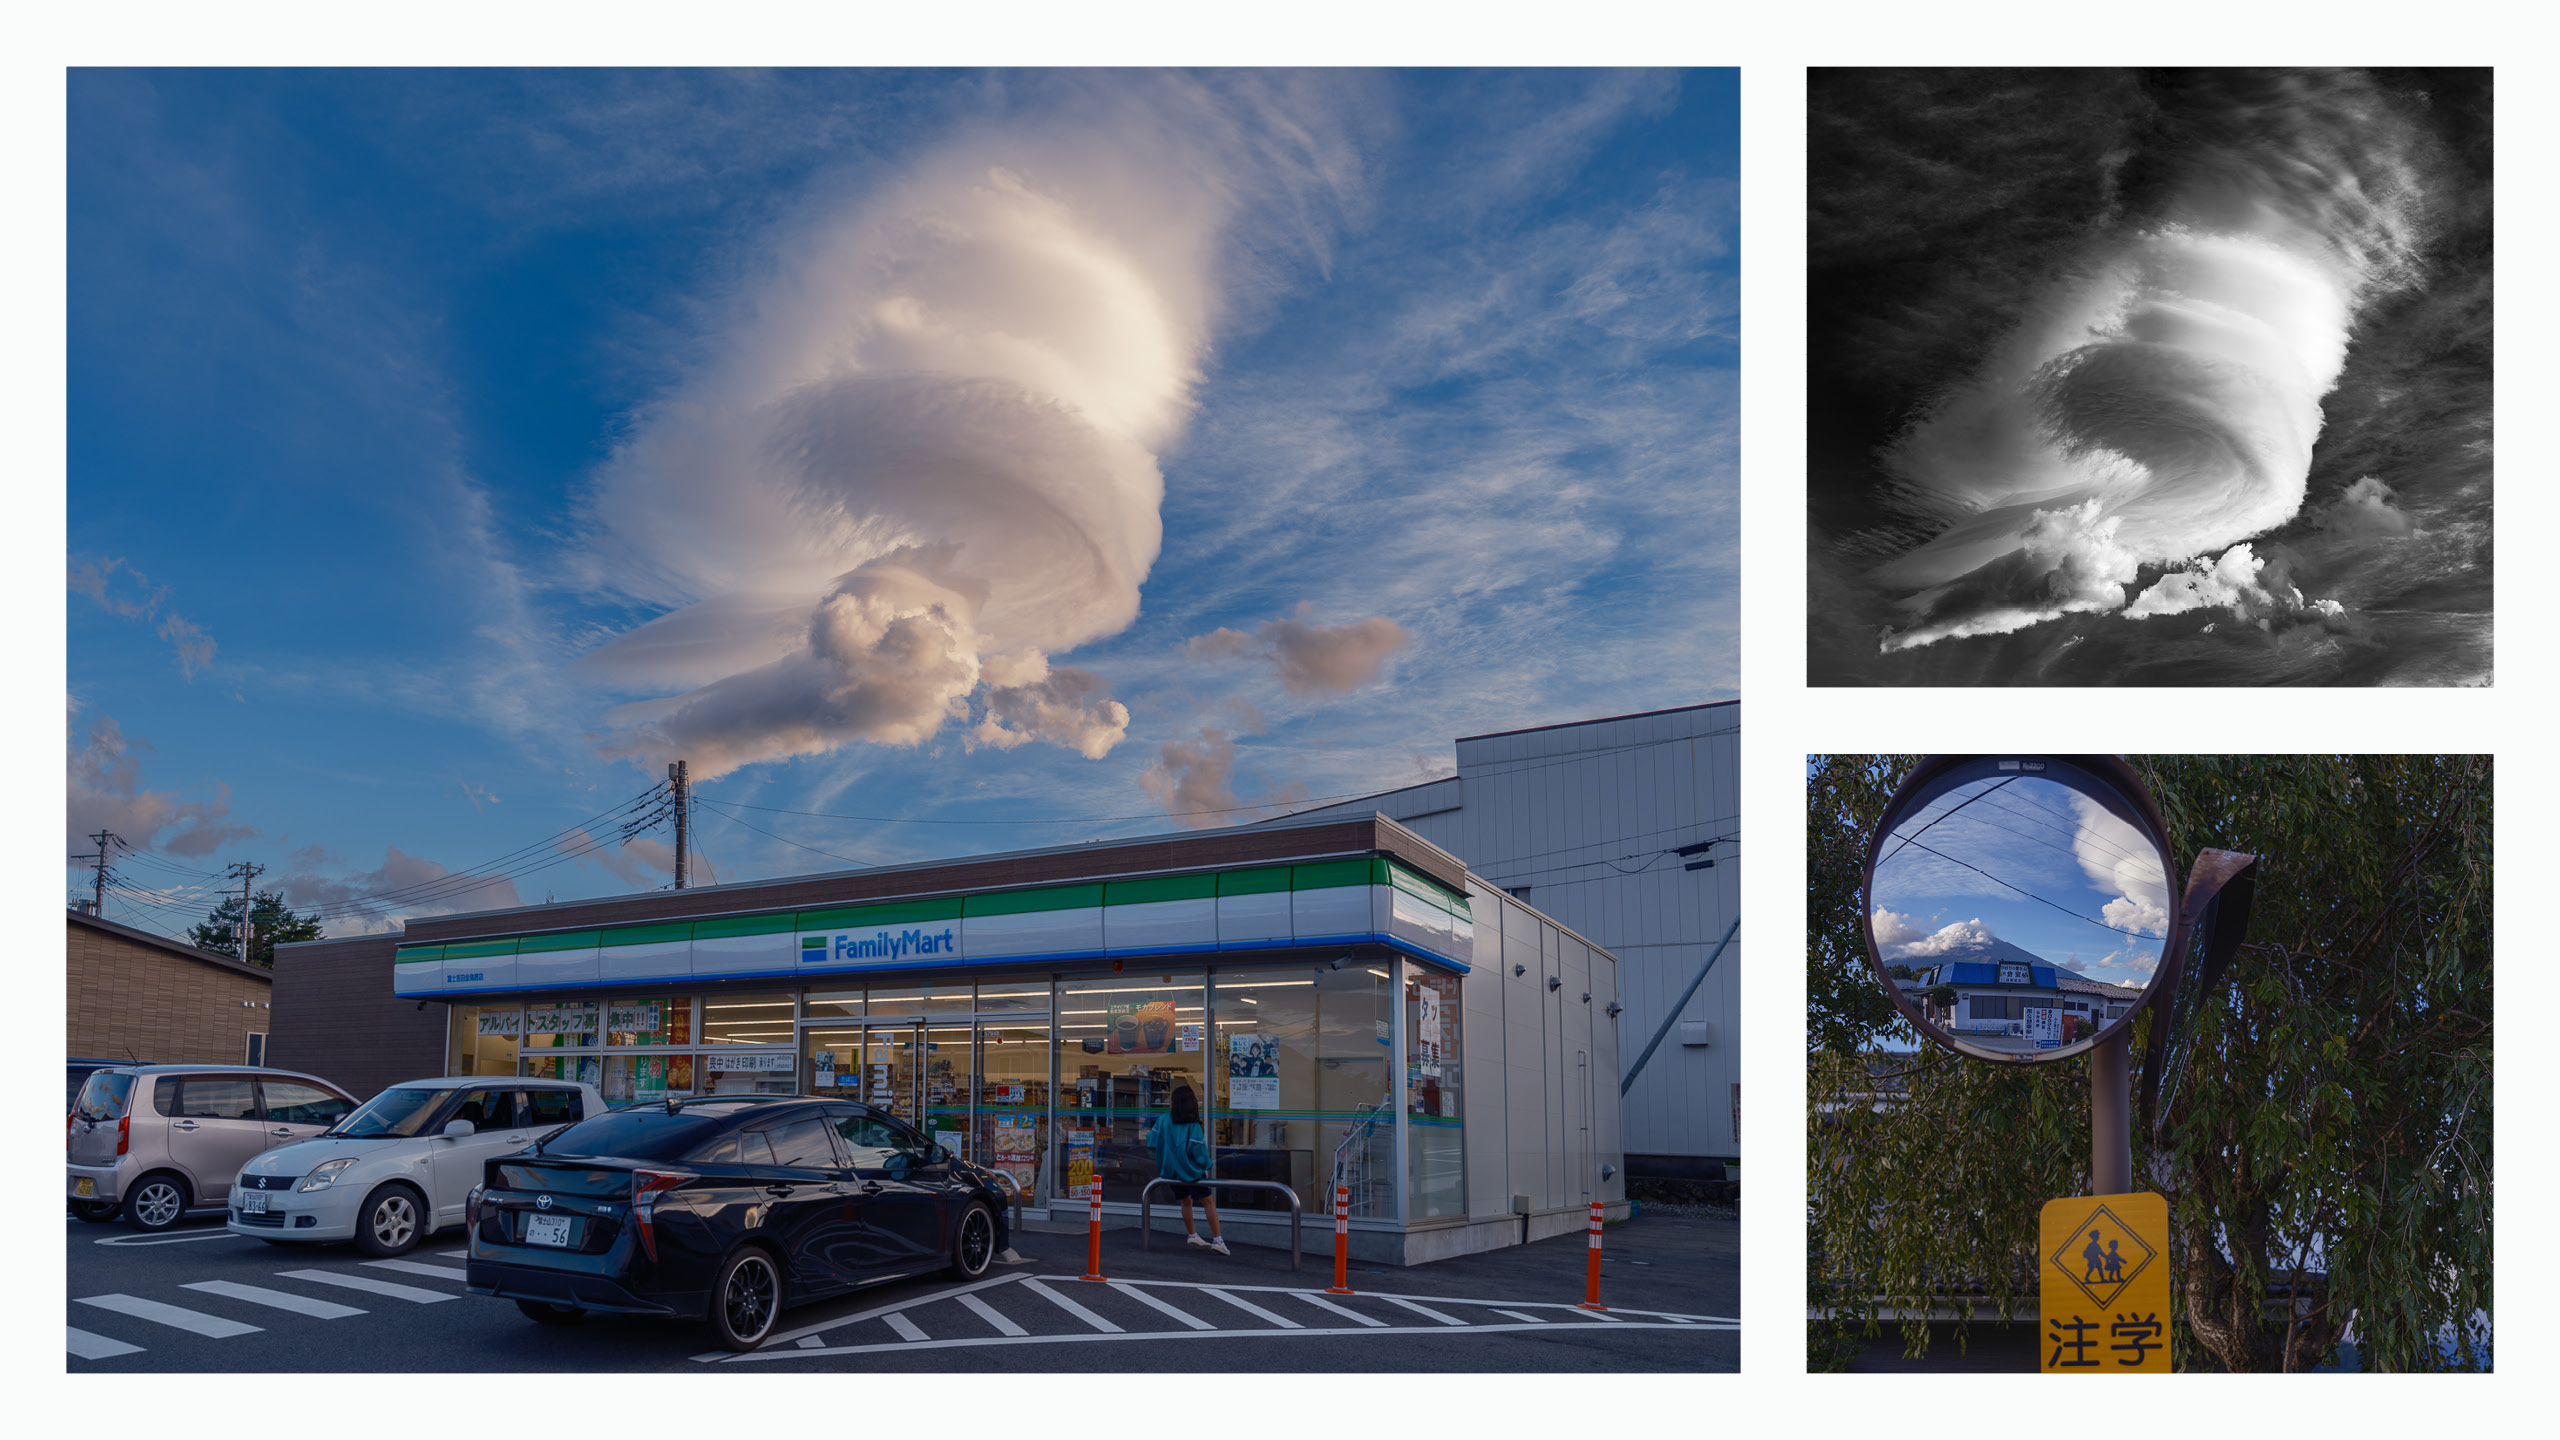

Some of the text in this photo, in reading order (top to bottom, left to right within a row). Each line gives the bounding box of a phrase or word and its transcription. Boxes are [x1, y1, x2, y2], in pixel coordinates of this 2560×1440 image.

[835, 928, 953, 960] FamilyMart
[1135, 1002, 1172, 1012] モカブレンド
